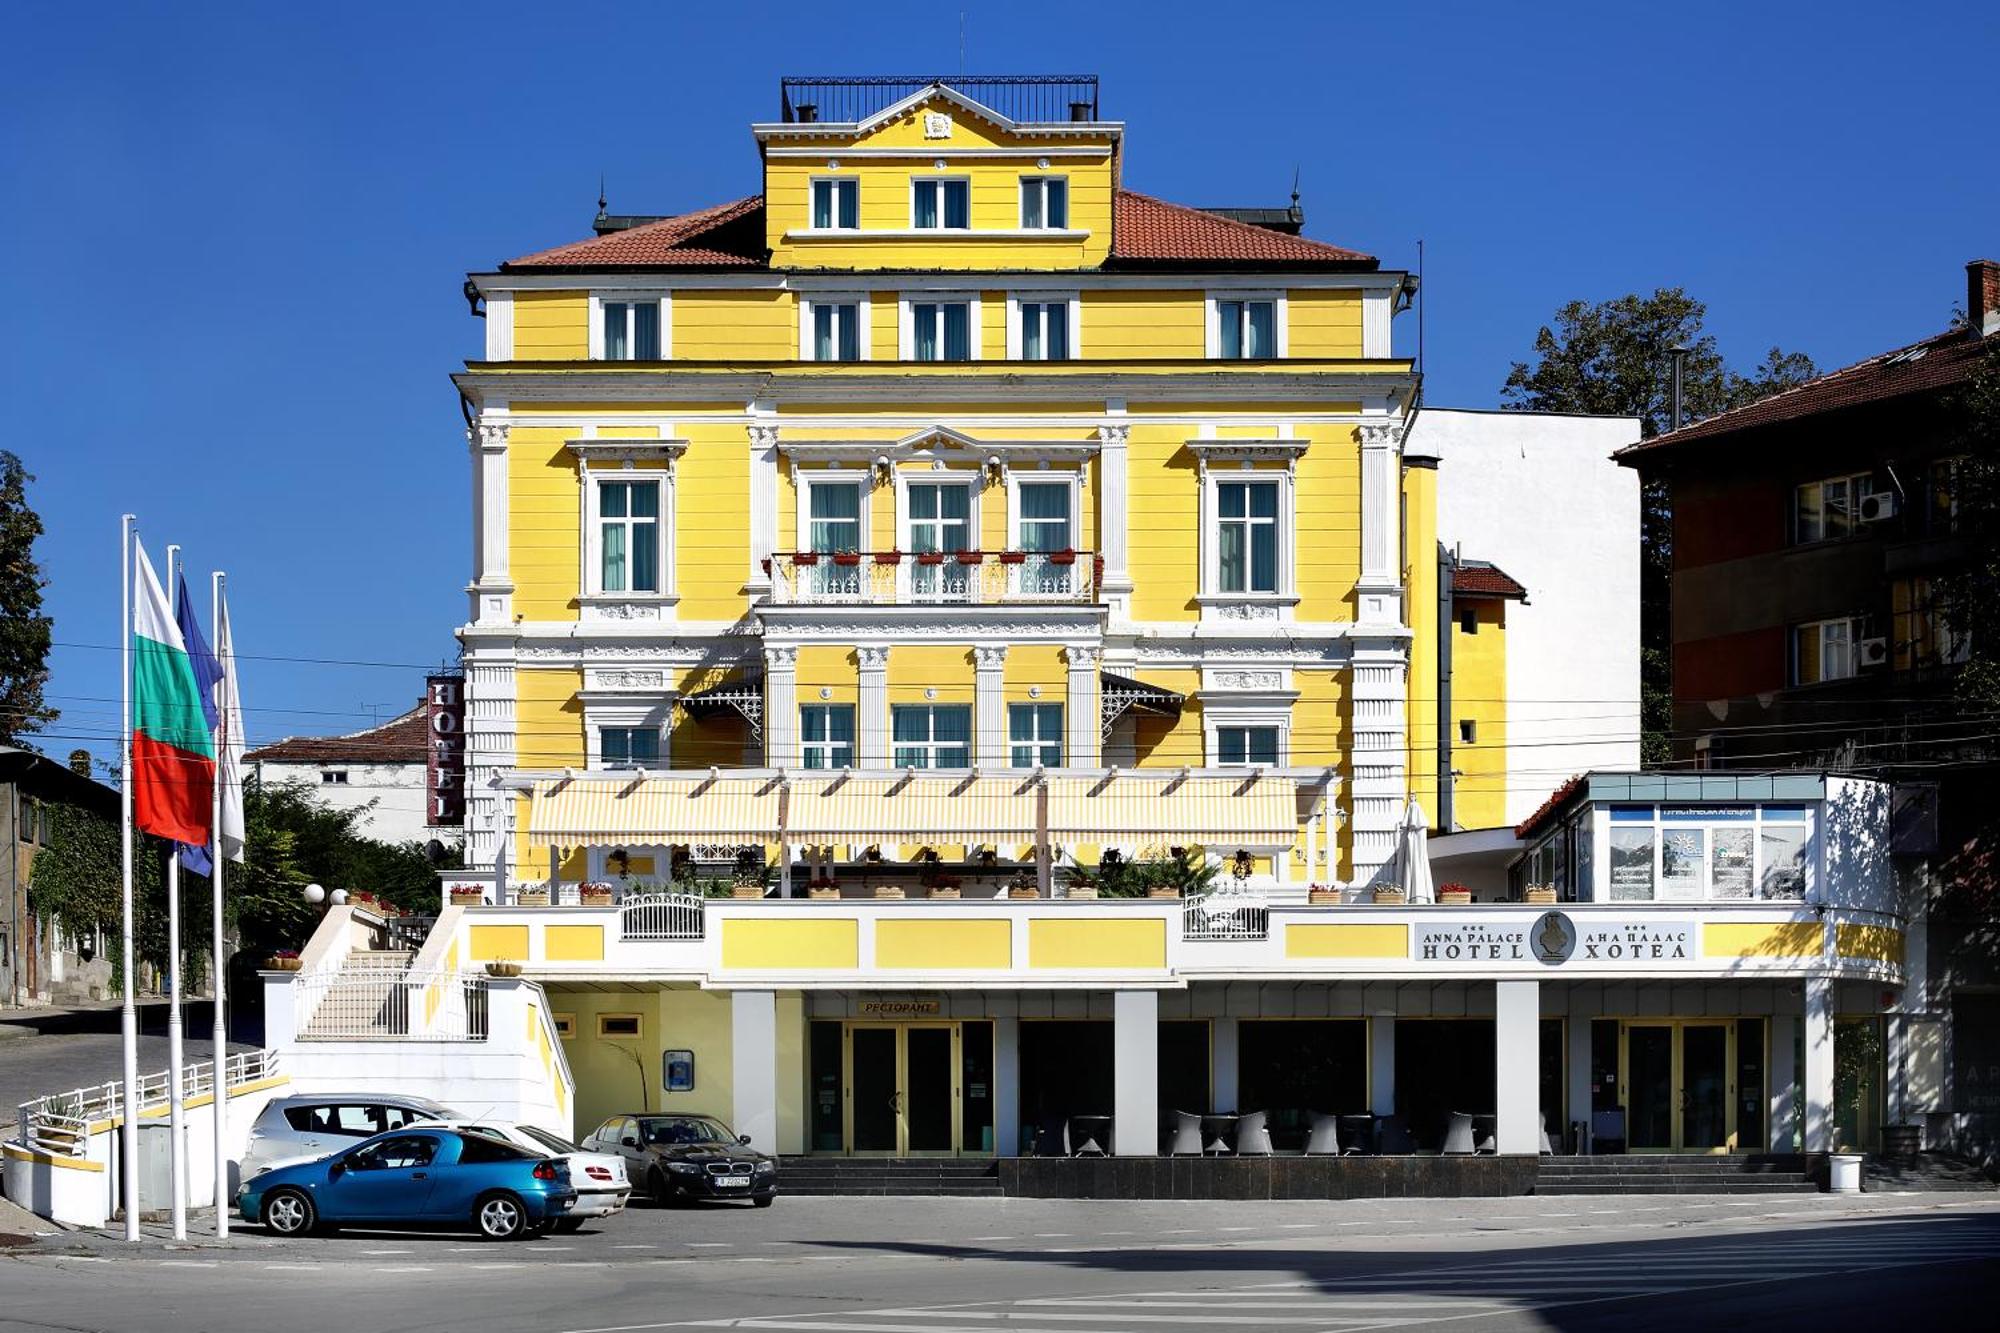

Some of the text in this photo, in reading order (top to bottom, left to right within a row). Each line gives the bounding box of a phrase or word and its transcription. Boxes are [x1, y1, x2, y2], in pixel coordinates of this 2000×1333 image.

[433, 684, 457, 817] HOTEL
[1423, 934, 1523, 943] ANNA PALACE
[1586, 933, 1685, 942] АНА ПАЛАС
[1423, 945, 1523, 959] HOTEL
[1585, 945, 1685, 959] ХОТЕЛ
[865, 1002, 931, 1013] РЕСТОРАНТ
